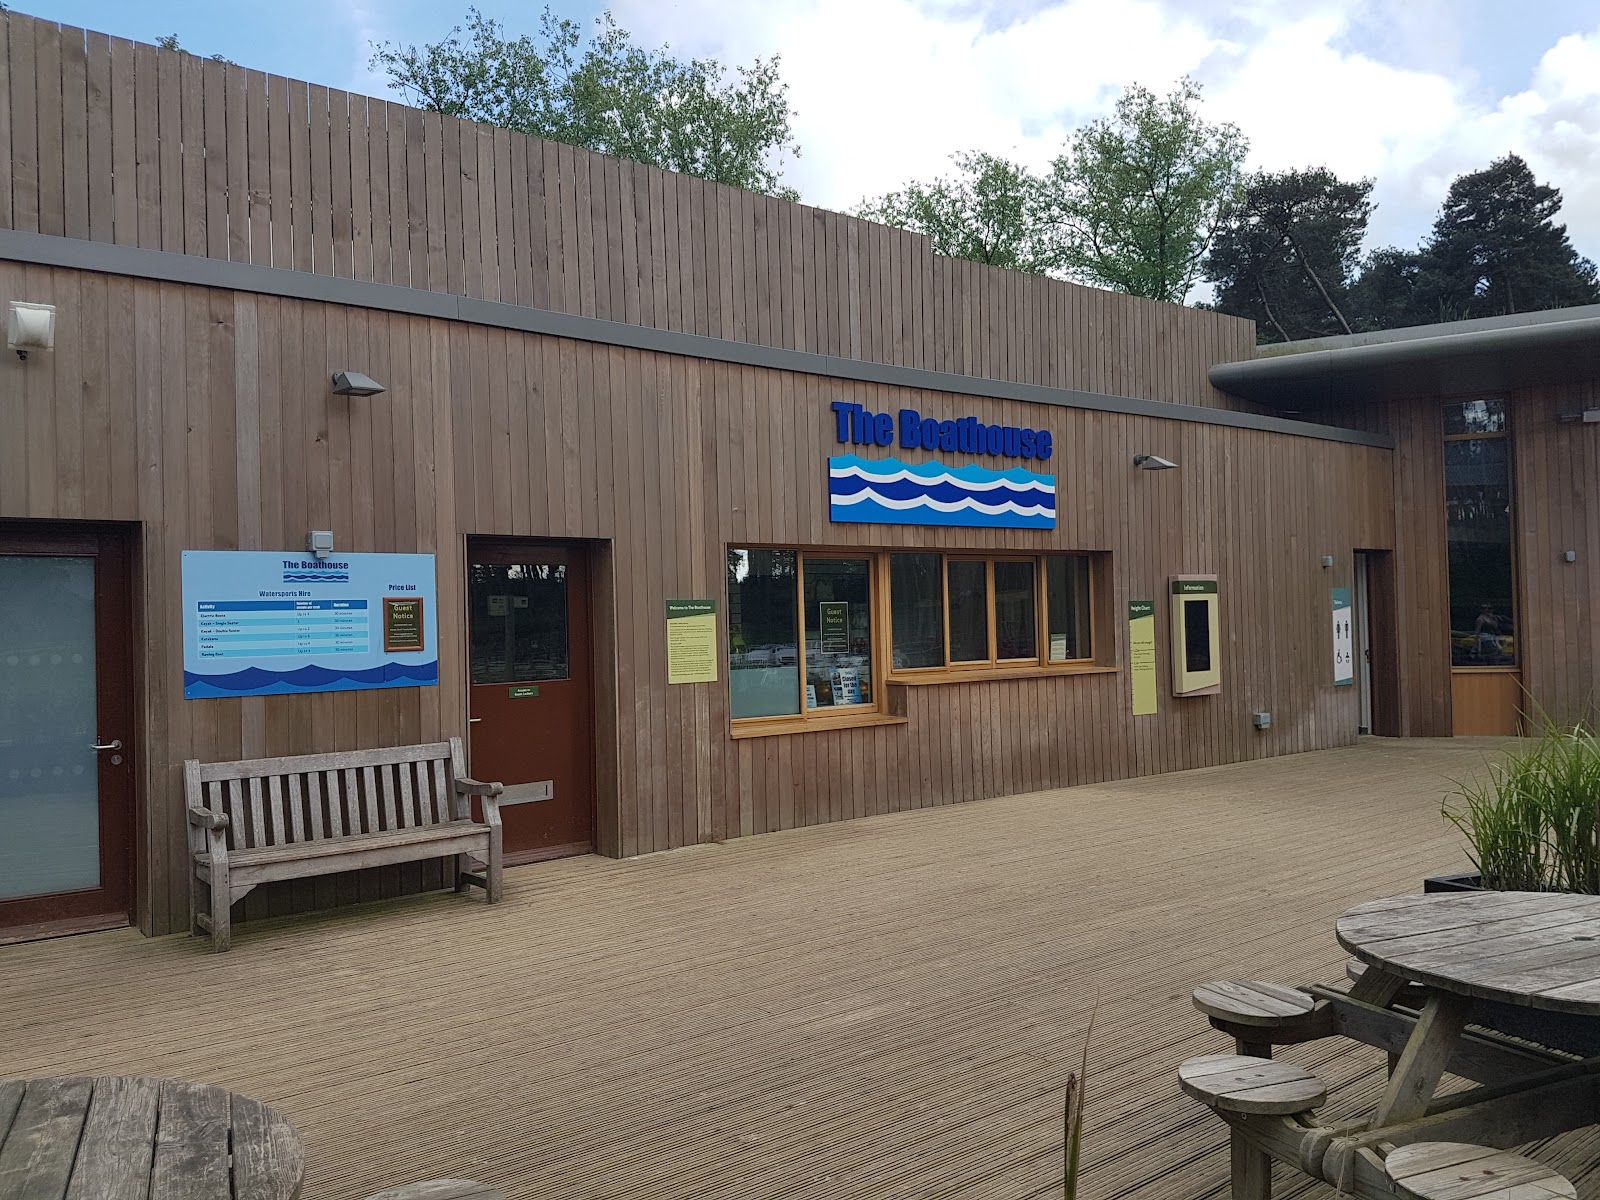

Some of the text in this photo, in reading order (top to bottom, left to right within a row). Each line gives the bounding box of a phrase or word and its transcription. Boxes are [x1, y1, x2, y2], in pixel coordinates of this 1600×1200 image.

[831, 401, 1053, 460] The Boathouse
[282, 561, 348, 569] The Boathouse
